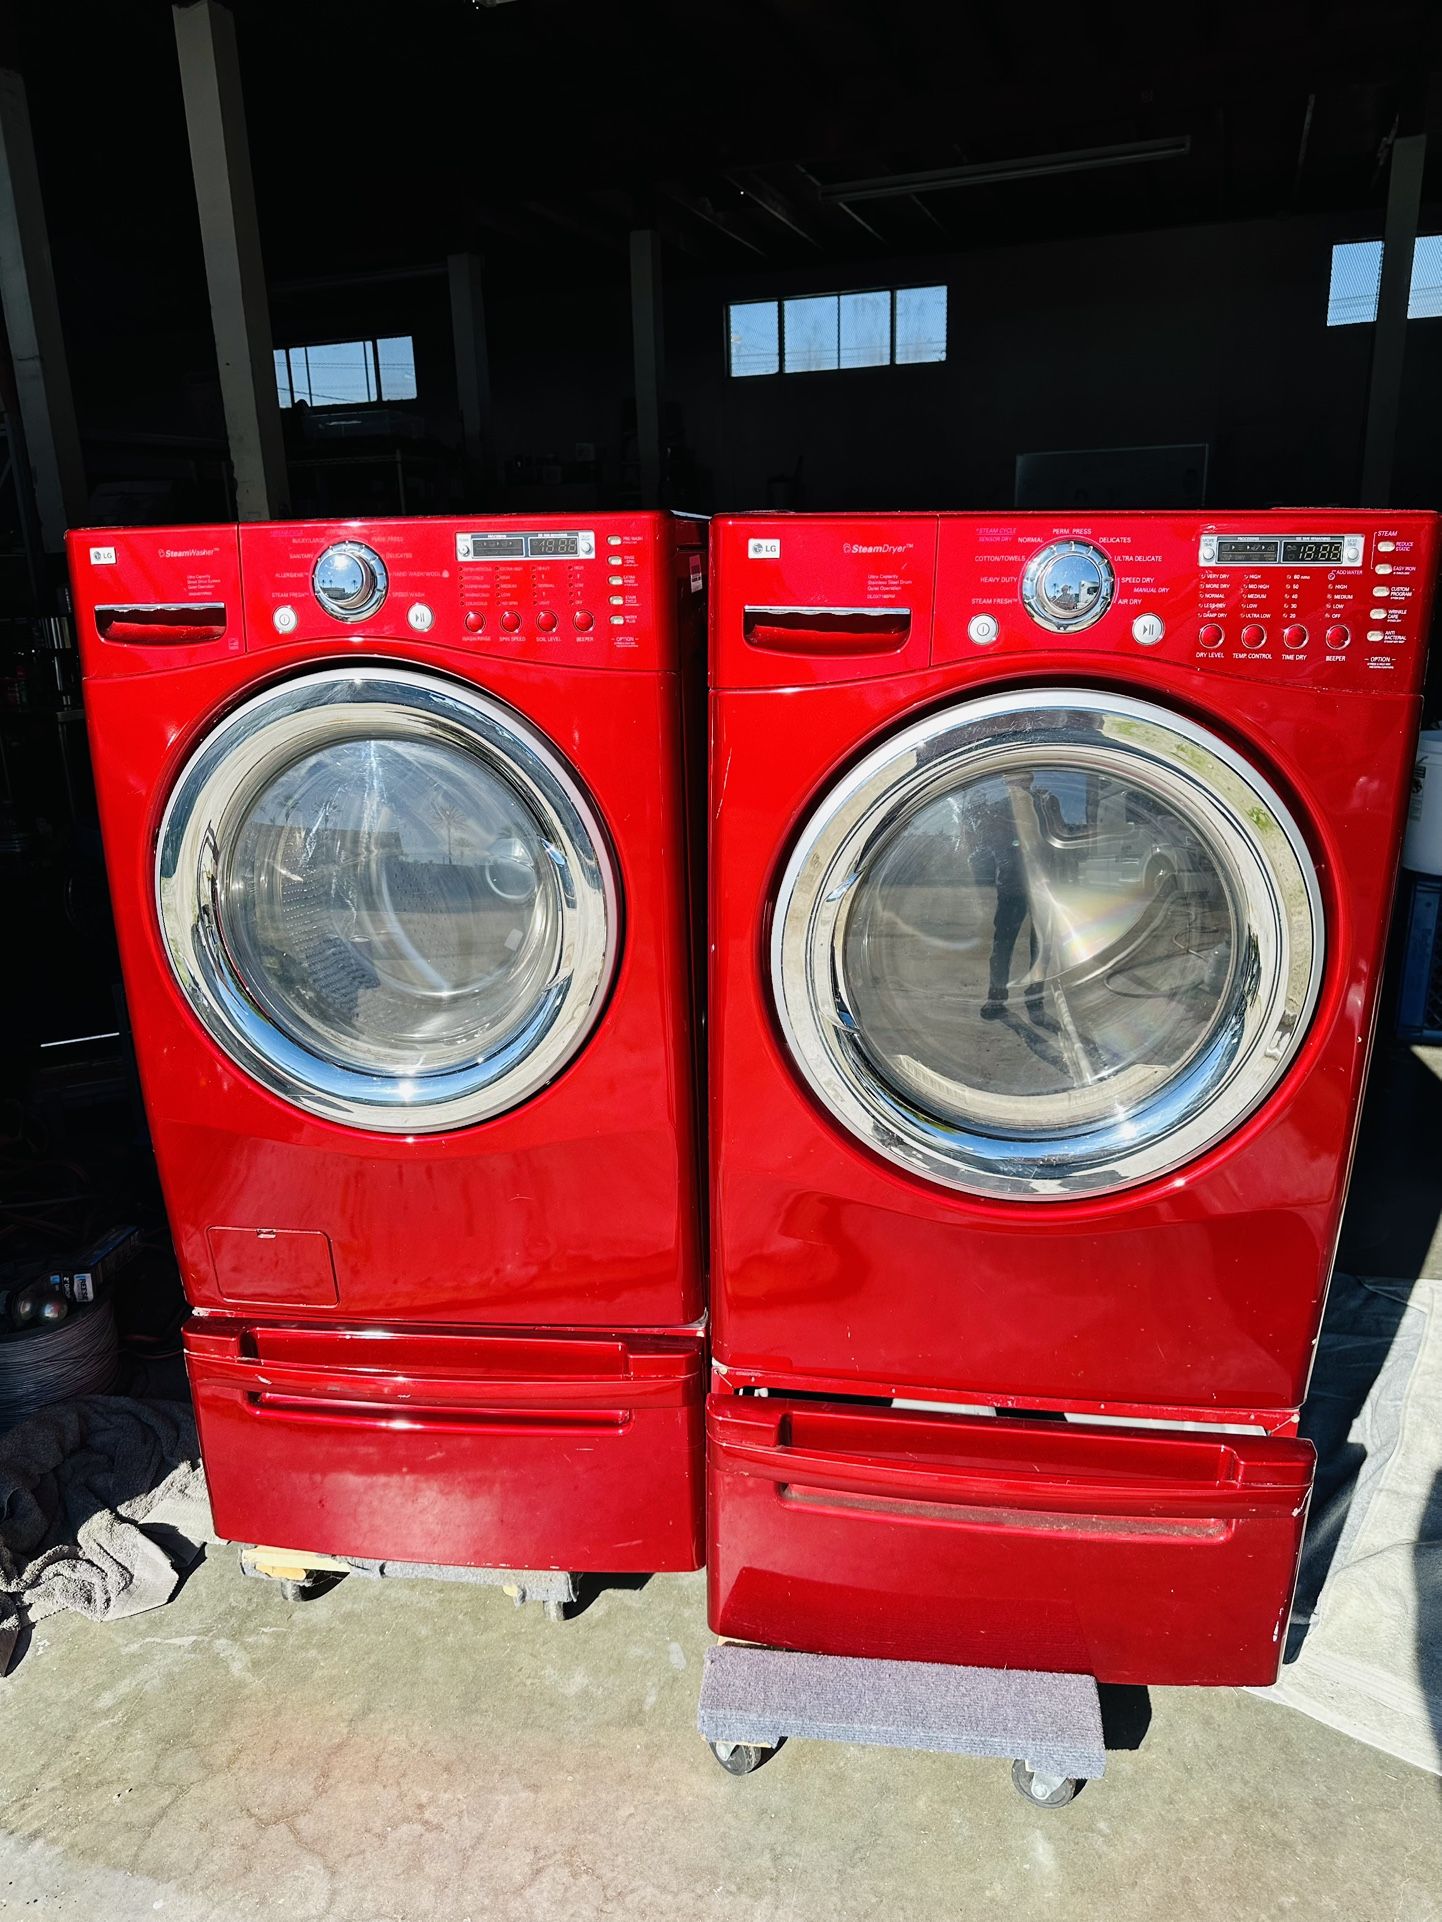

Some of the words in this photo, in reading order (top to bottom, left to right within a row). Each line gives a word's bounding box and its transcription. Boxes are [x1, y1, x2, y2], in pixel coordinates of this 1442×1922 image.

[1098, 536, 1132, 544] DELICATES
[765, 544, 777, 553] LG
[1141, 576, 1155, 584] DRY
